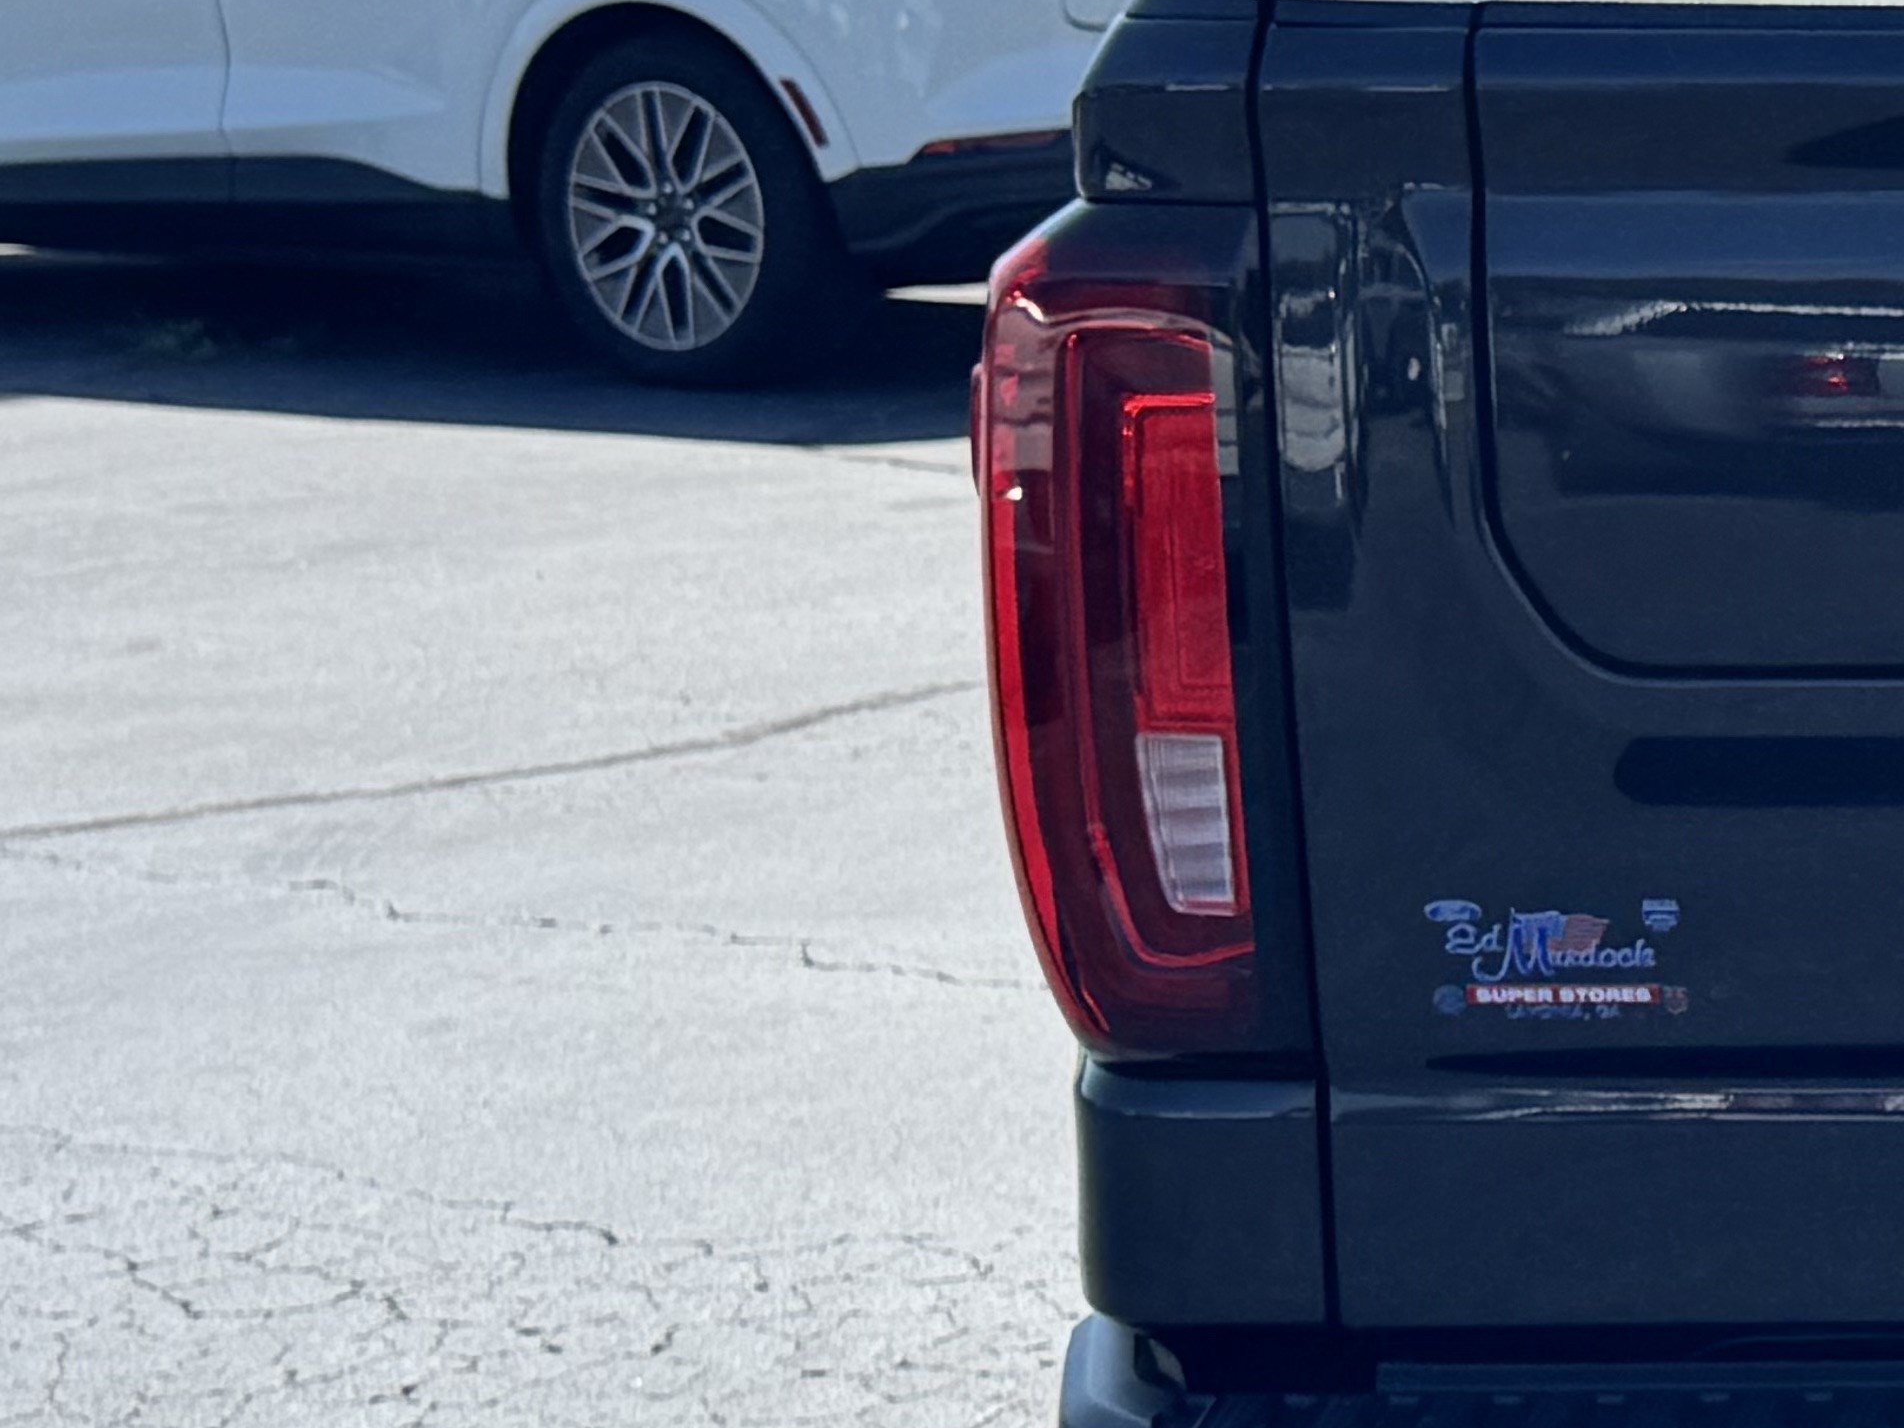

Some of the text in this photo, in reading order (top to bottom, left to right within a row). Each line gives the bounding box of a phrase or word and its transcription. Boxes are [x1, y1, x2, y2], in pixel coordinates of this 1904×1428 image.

[1445, 923, 1504, 955] Ed
[1471, 907, 1656, 982] Murdock
[1475, 986, 1652, 1003] SUPER STORES
